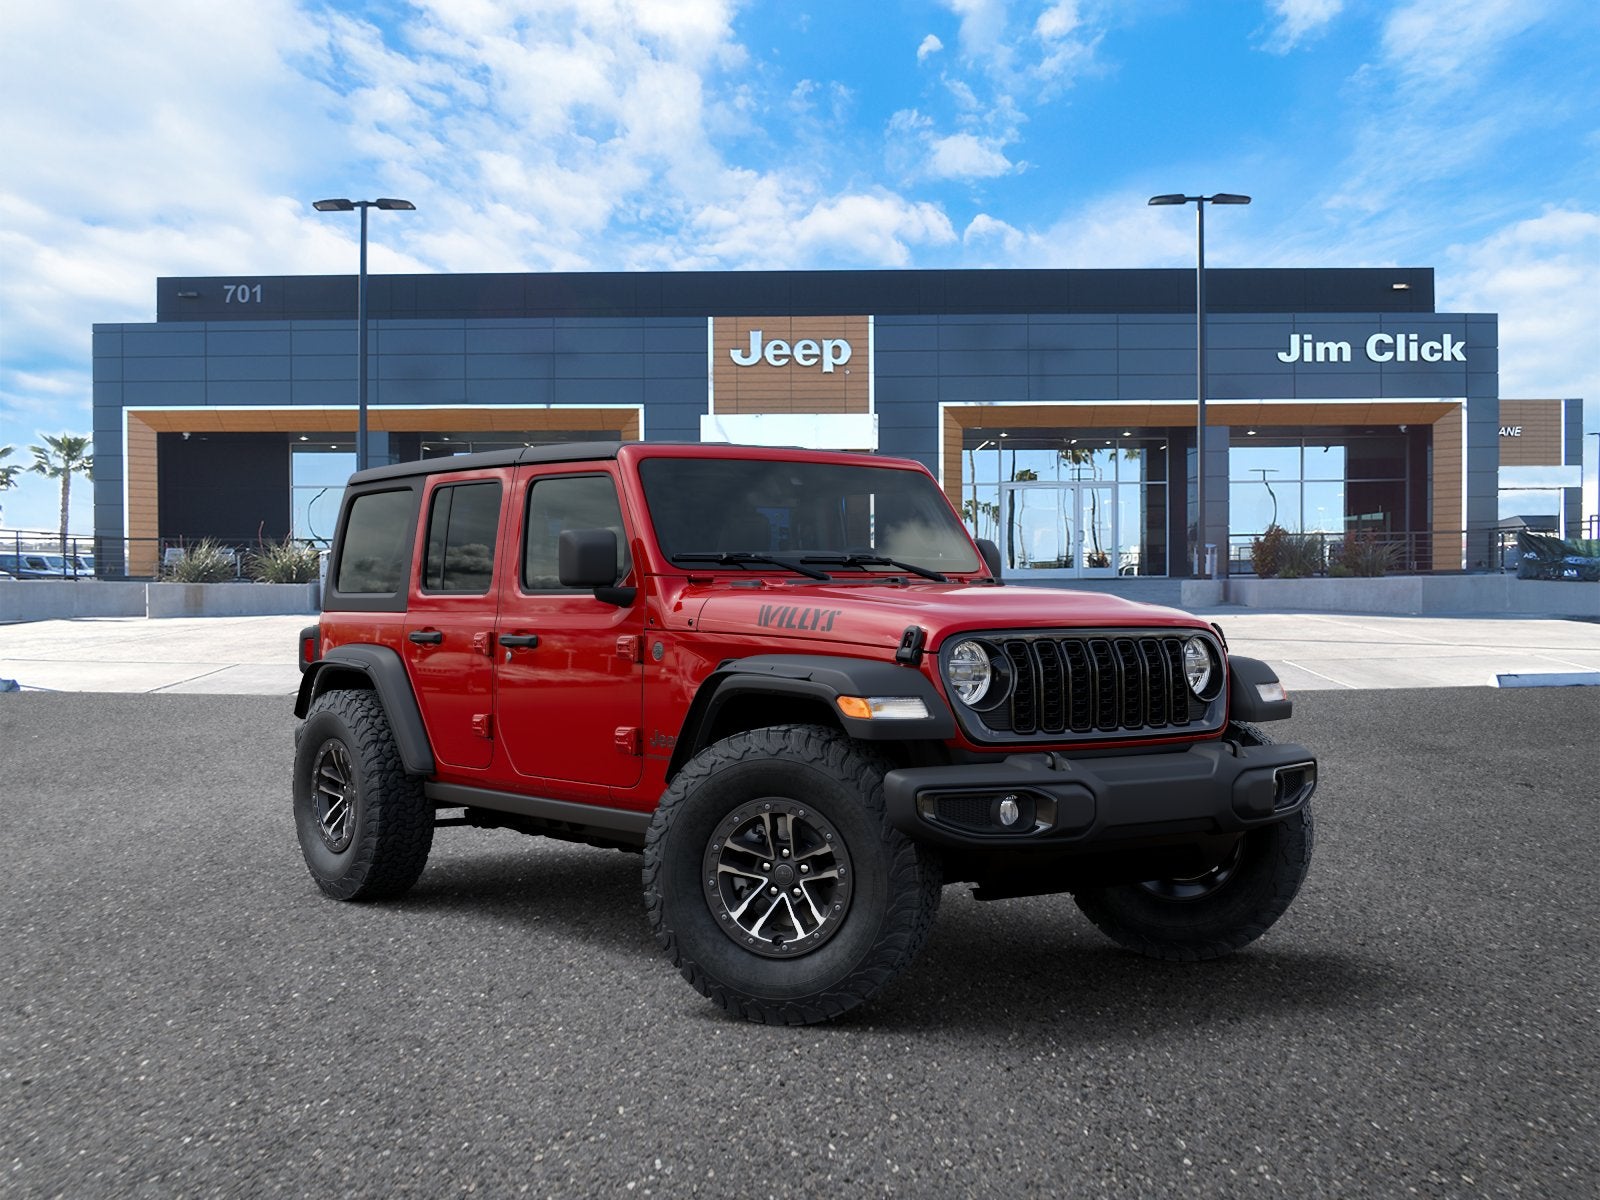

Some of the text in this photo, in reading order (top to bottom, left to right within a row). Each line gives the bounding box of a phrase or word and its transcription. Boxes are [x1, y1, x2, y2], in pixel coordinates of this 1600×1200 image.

[223, 284, 262, 303] 701
[729, 330, 852, 373] Jeep
[1277, 333, 1467, 363] Jim Click
[757, 605, 842, 632] WILLYS
[649, 729, 678, 749] Jee
